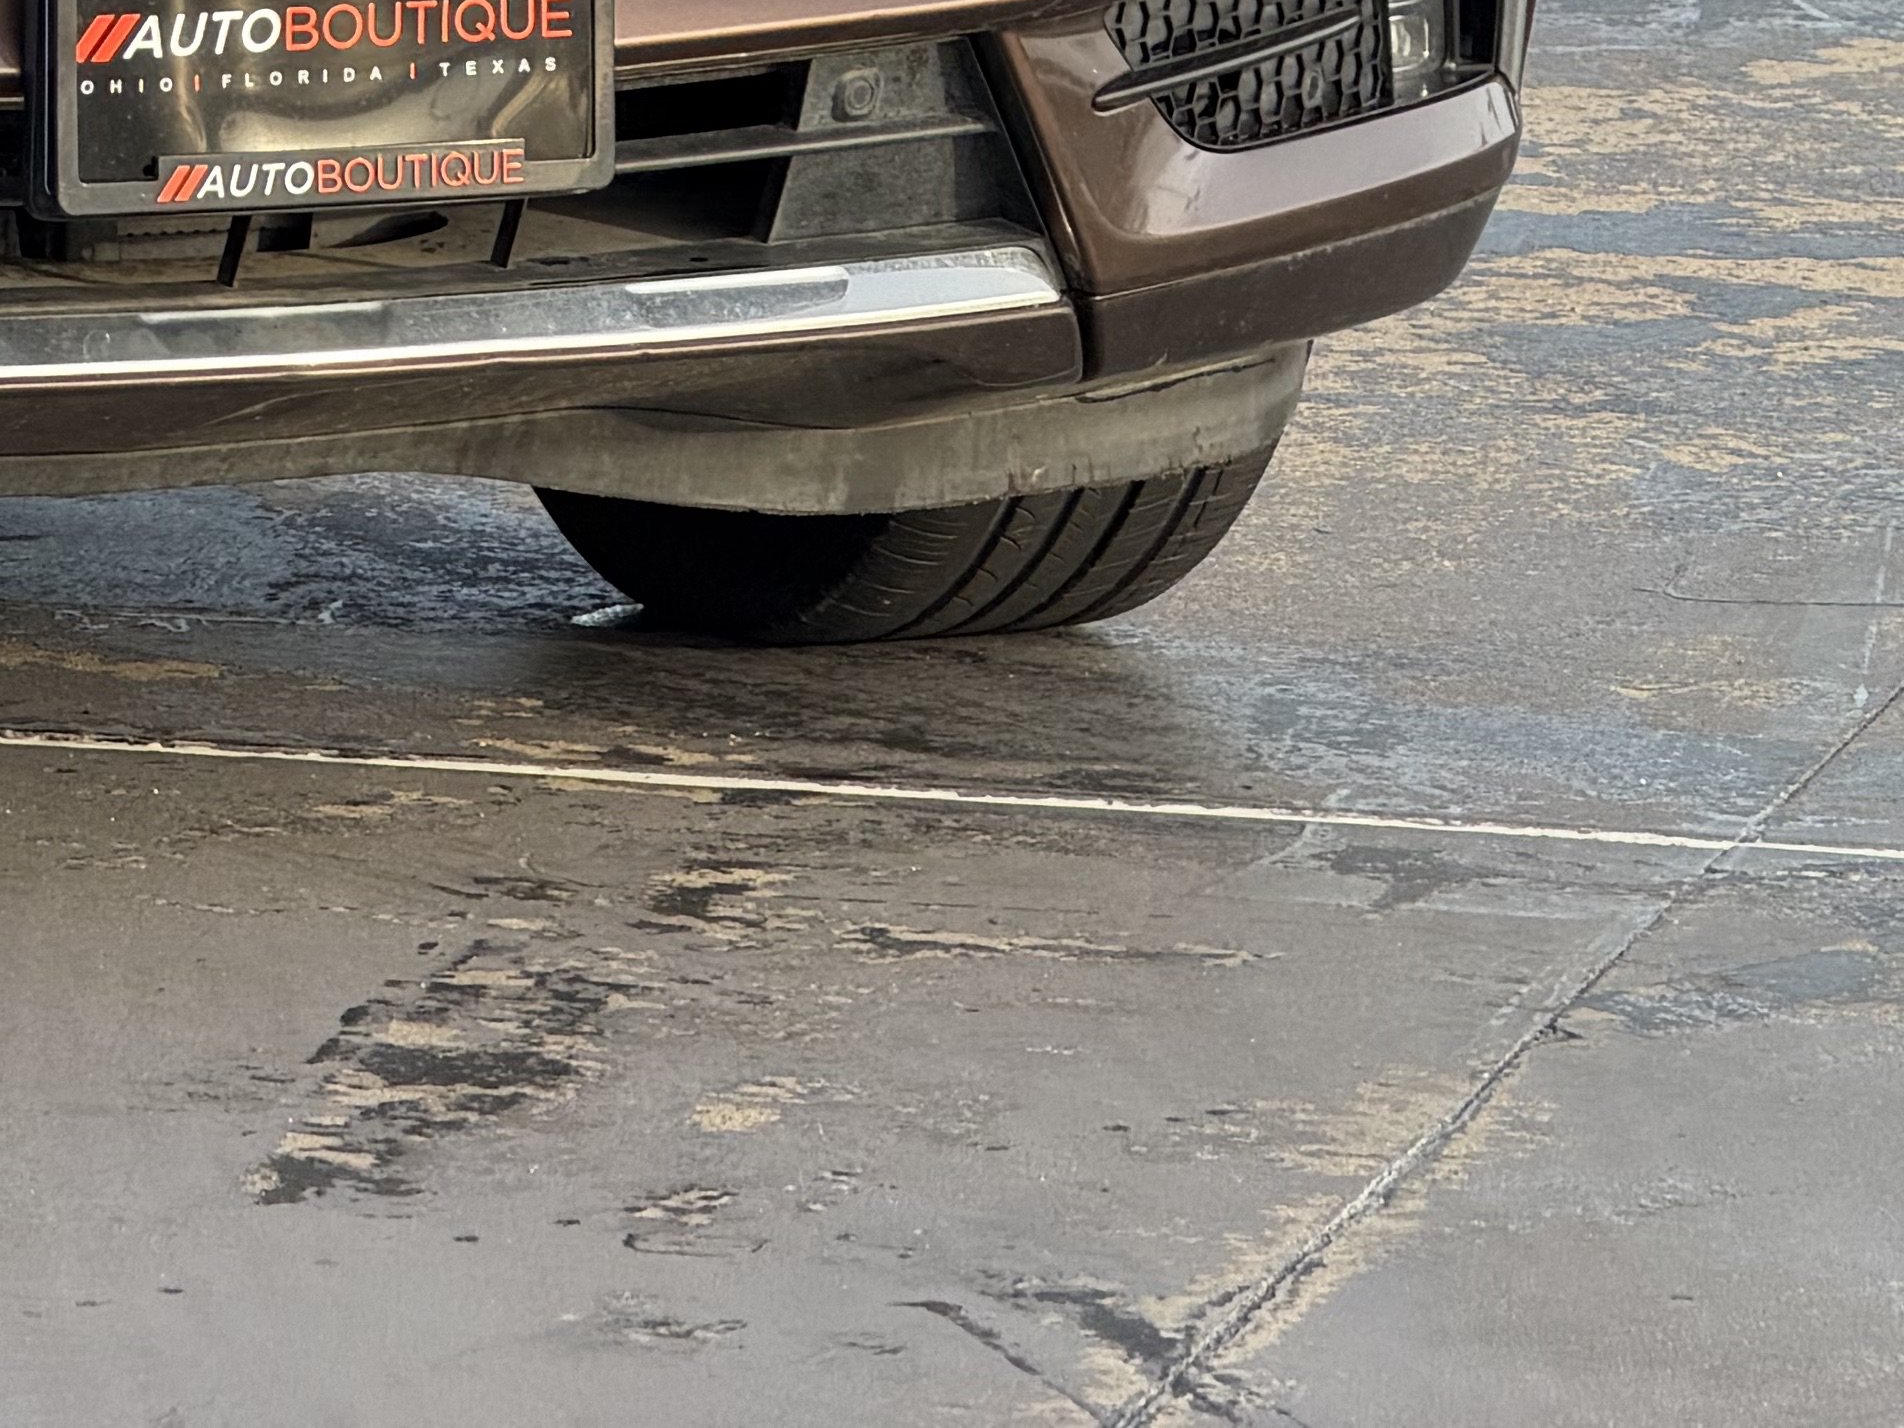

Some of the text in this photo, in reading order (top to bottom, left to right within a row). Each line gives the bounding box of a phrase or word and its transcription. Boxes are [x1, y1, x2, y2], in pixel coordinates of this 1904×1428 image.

[79, 56, 559, 96] OHIO FLORIDA TEXAS
